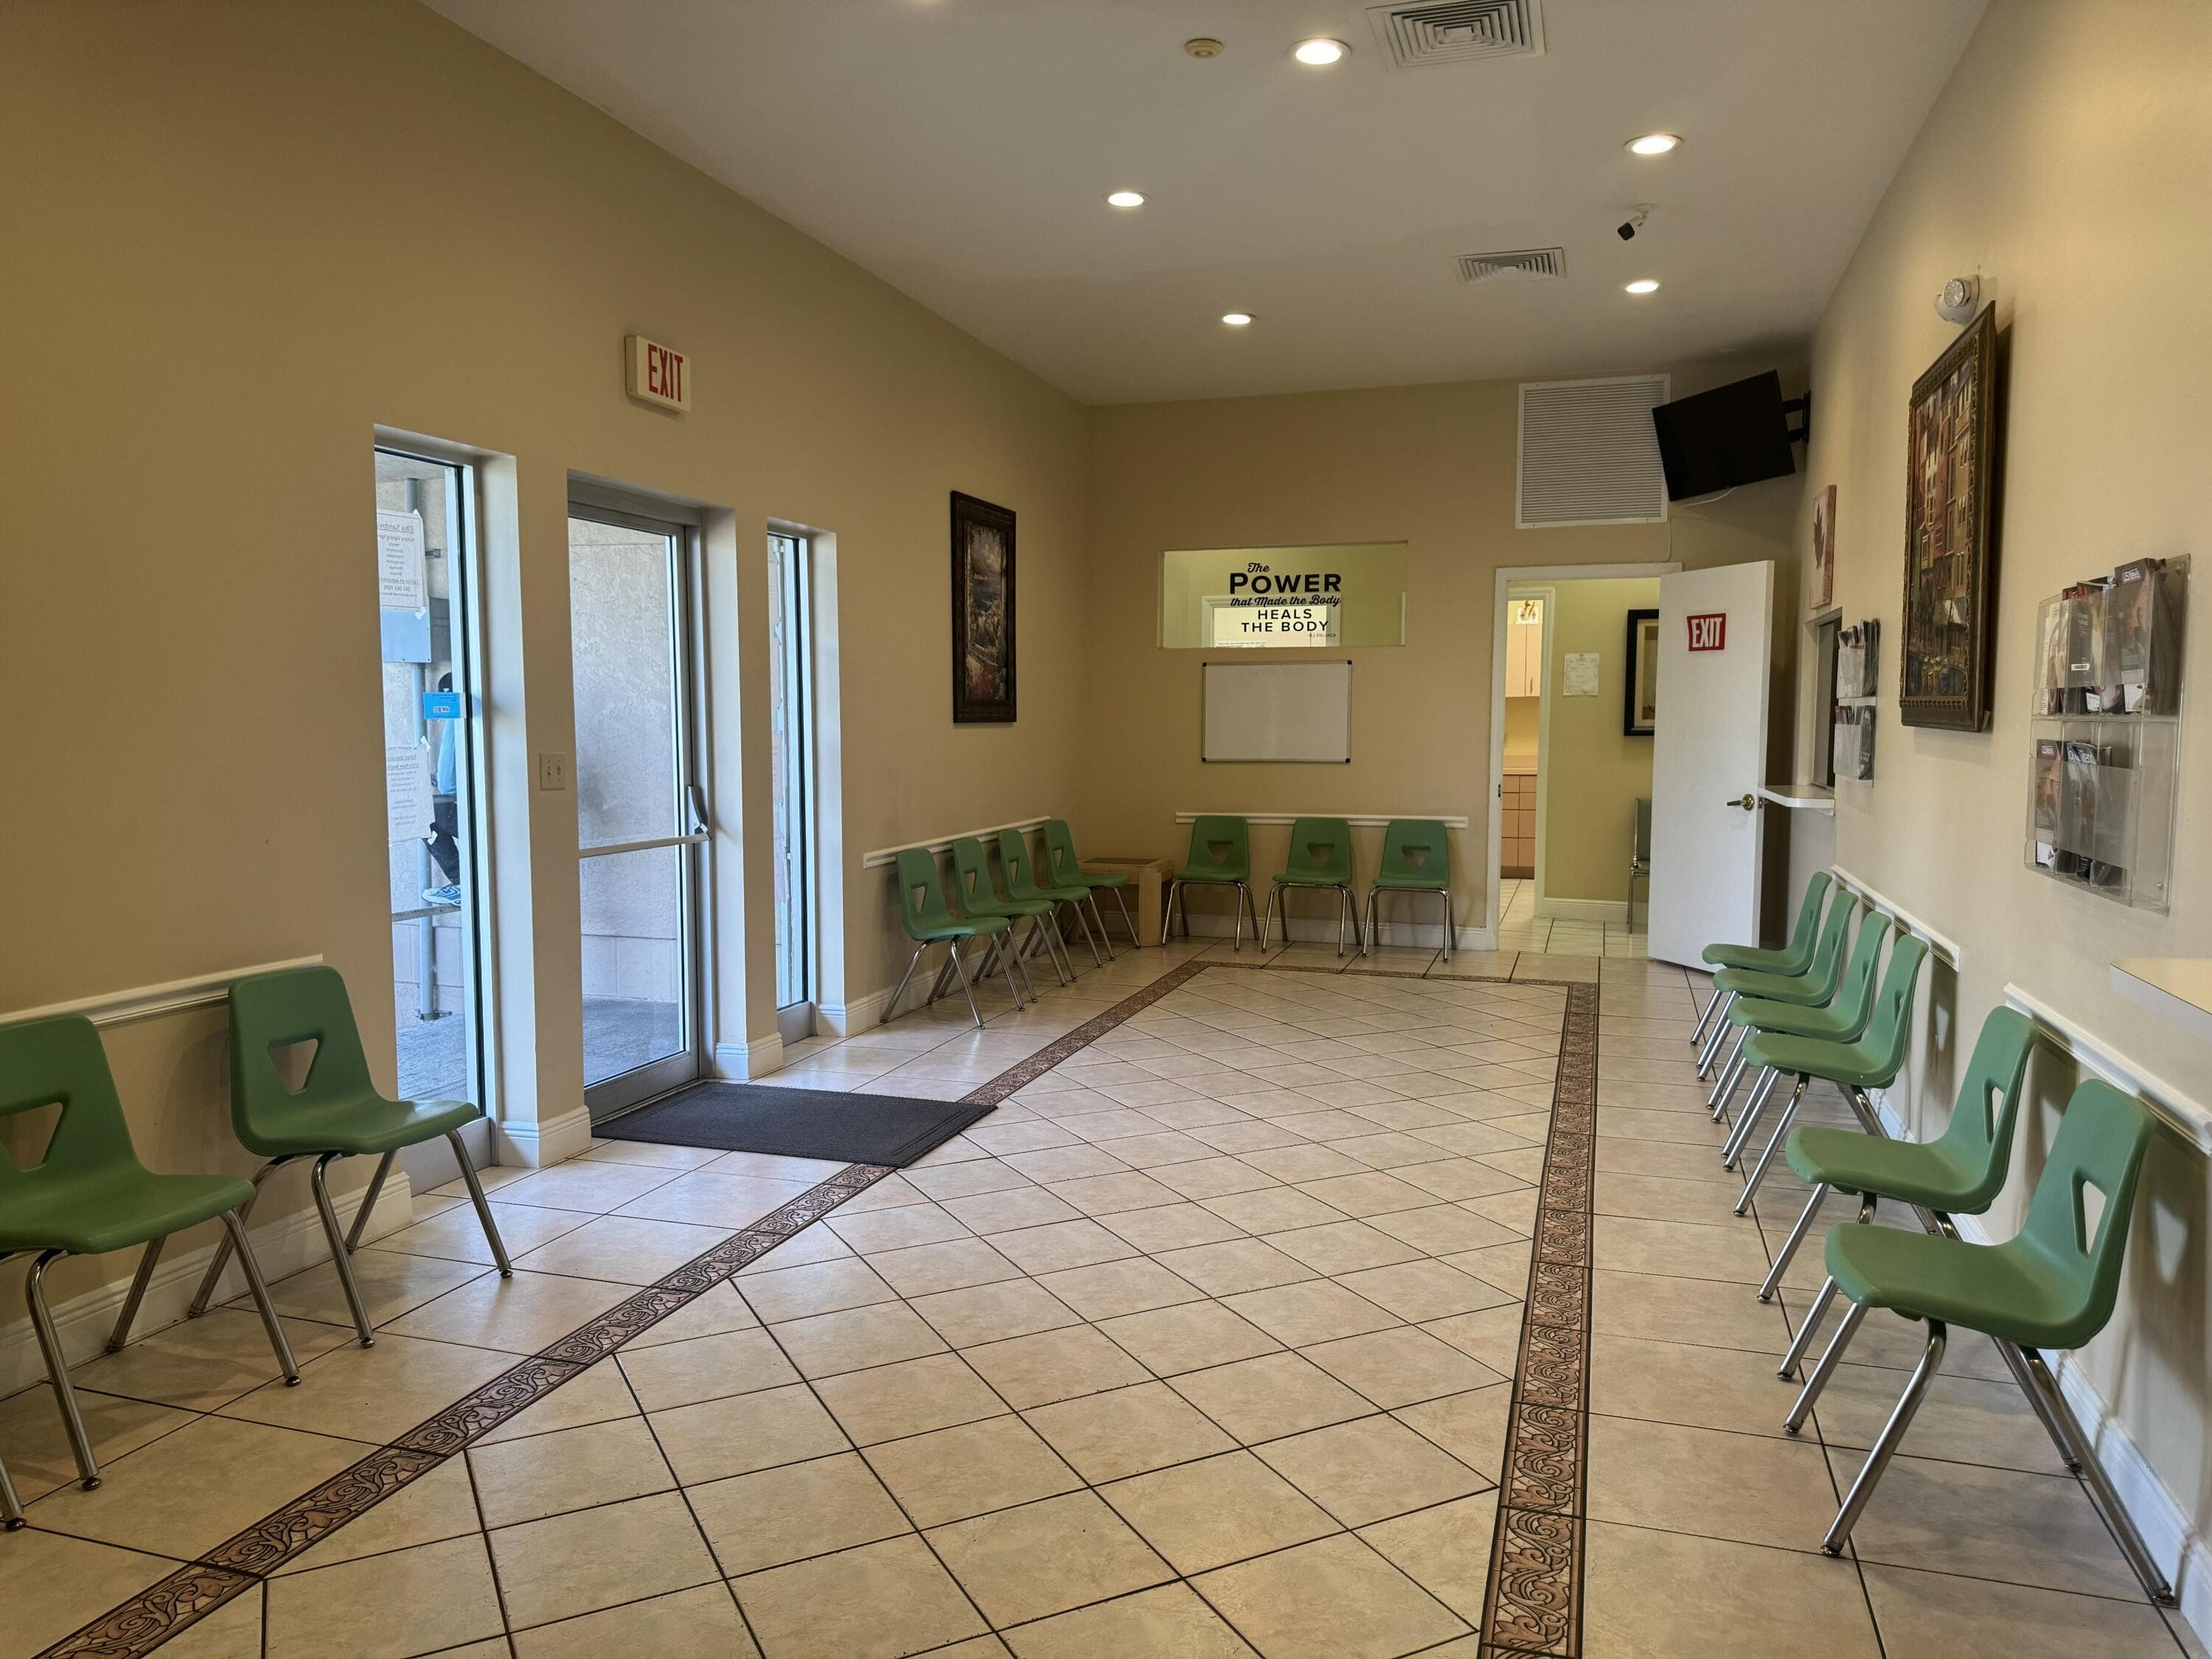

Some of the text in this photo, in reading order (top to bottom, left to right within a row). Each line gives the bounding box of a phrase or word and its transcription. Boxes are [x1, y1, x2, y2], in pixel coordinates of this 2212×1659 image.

[648, 343, 683, 403] EXIT
[1248, 562, 1270, 573] The
[1230, 572, 1341, 594] POWER
[1230, 594, 1341, 608] that Made the Body
[1258, 608, 1312, 620] HEALS
[1241, 621, 1329, 632] THE BODY
[1691, 617, 1722, 648] EXIT
